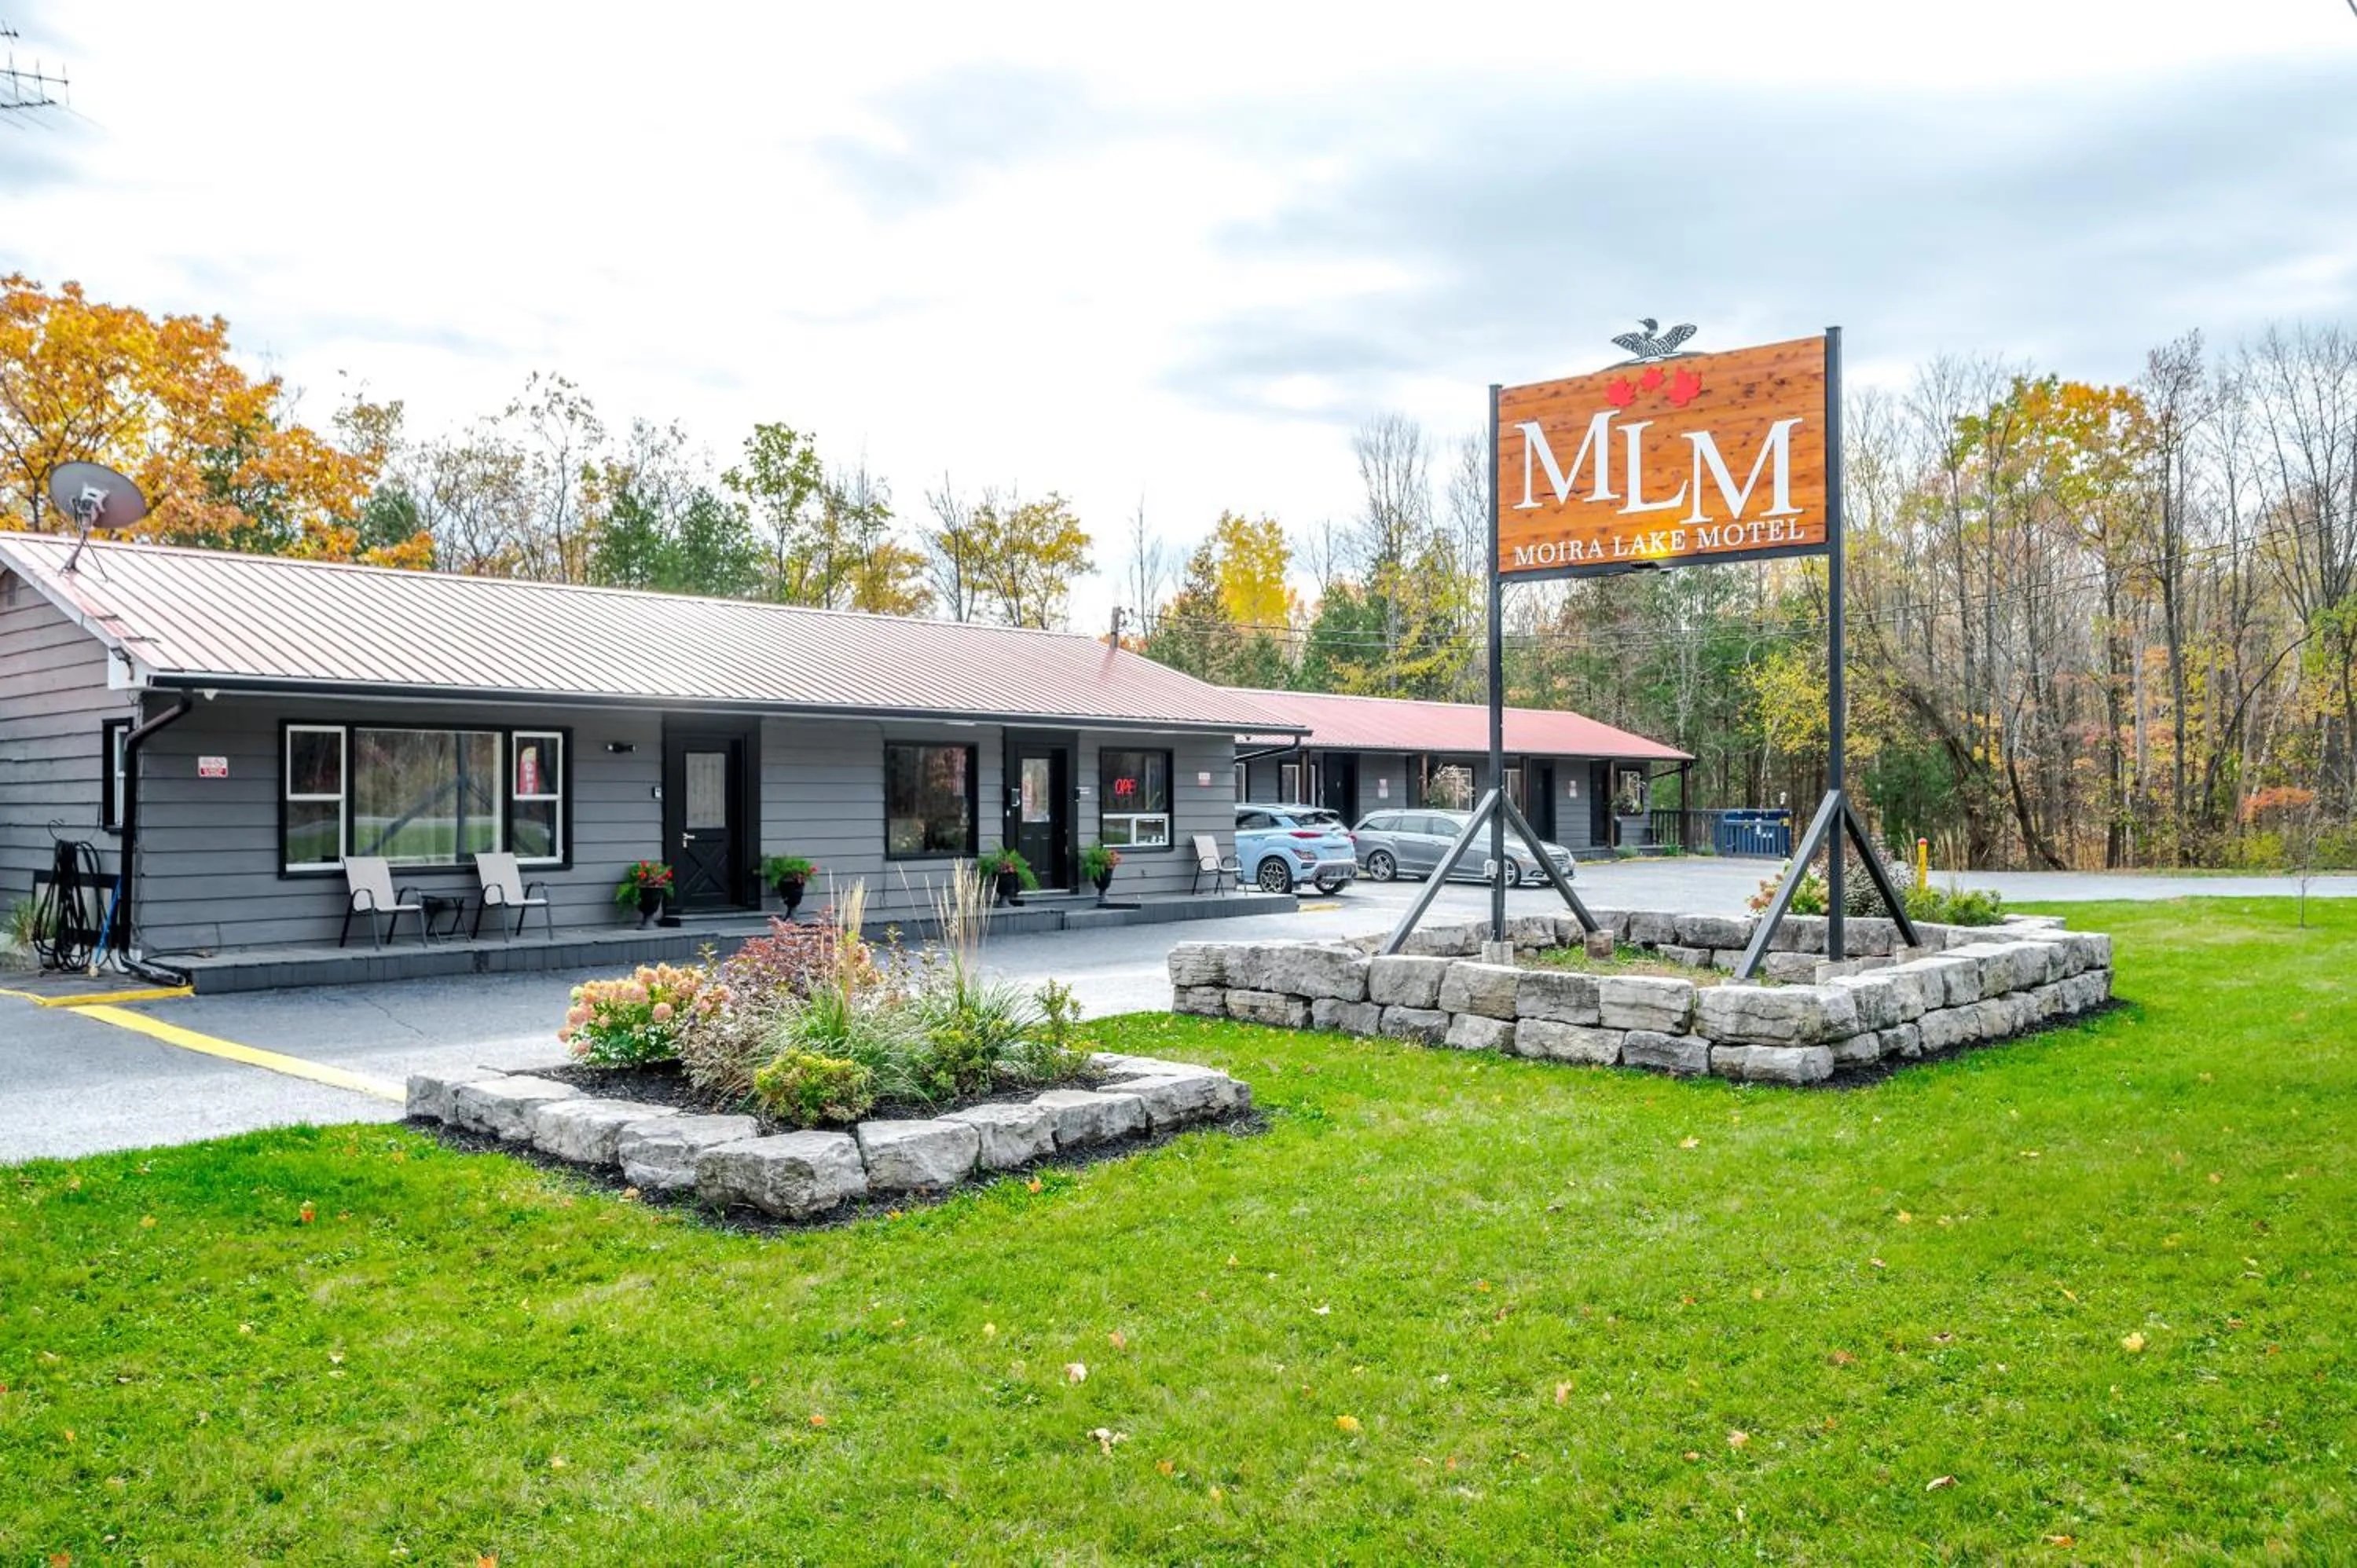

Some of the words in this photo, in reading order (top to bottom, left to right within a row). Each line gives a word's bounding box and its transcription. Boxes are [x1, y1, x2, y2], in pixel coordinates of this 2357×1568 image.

[1512, 408, 1805, 525] MLM
[1513, 537, 1605, 566] MOIRA
[1613, 529, 1686, 556] LAKE
[1696, 517, 1805, 549] MOTEL
